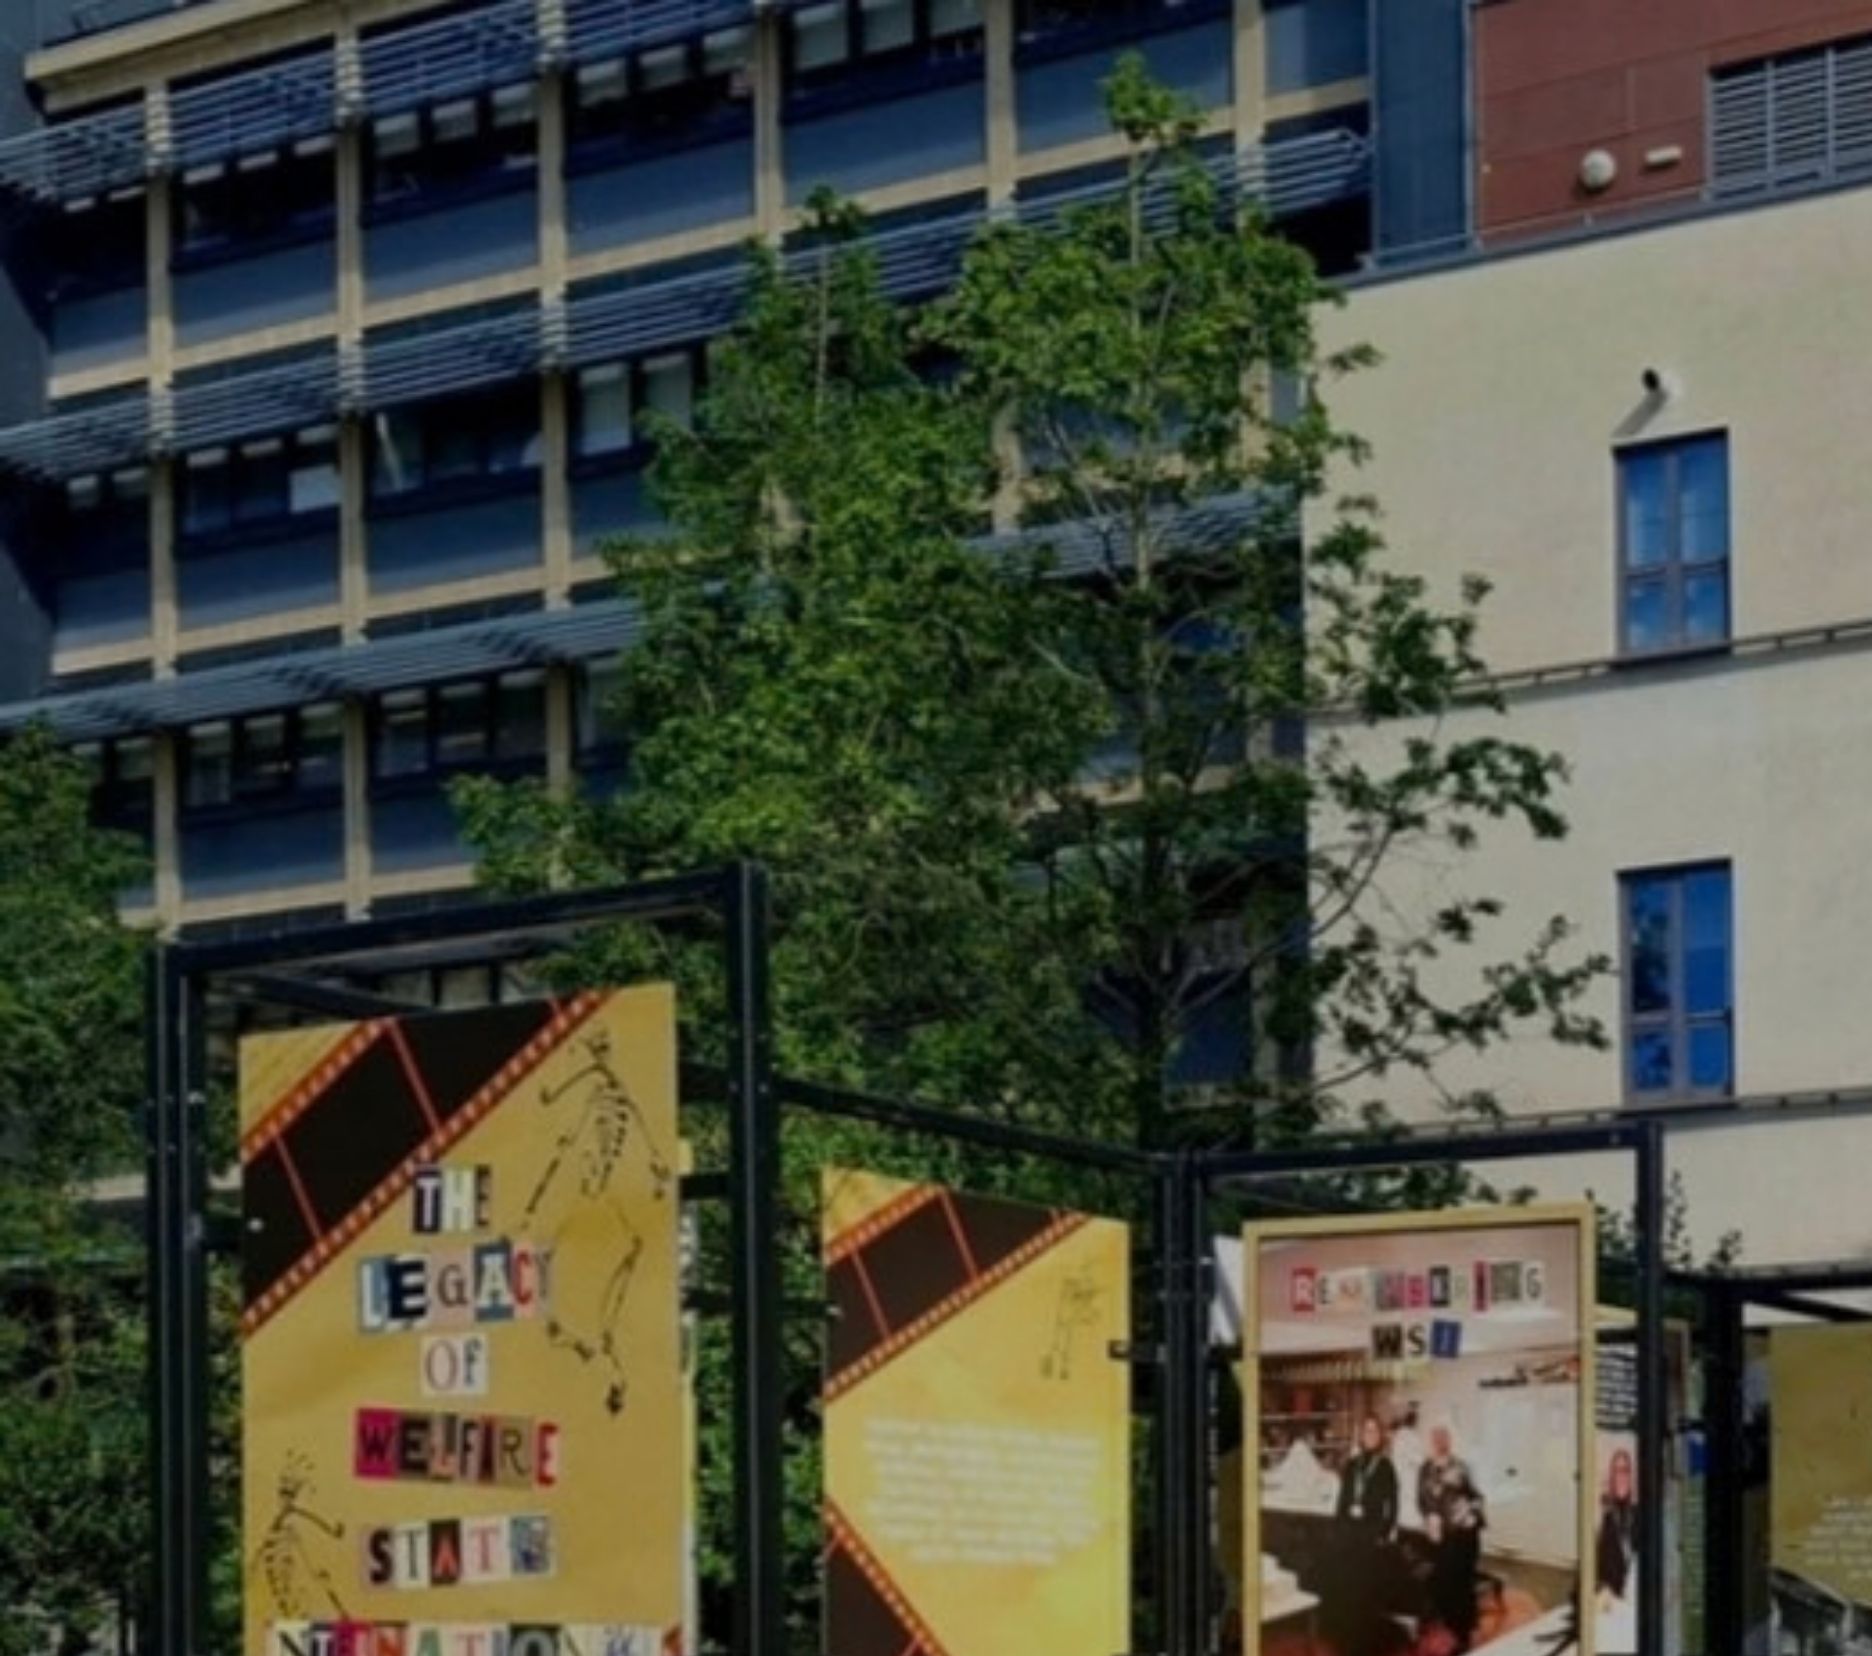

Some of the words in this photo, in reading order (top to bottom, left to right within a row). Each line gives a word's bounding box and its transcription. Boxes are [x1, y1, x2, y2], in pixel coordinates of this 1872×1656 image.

[416, 1165, 491, 1232] THE
[359, 1243, 551, 1331] LEGACY
[1293, 1263, 1542, 1312] REMMBRING
